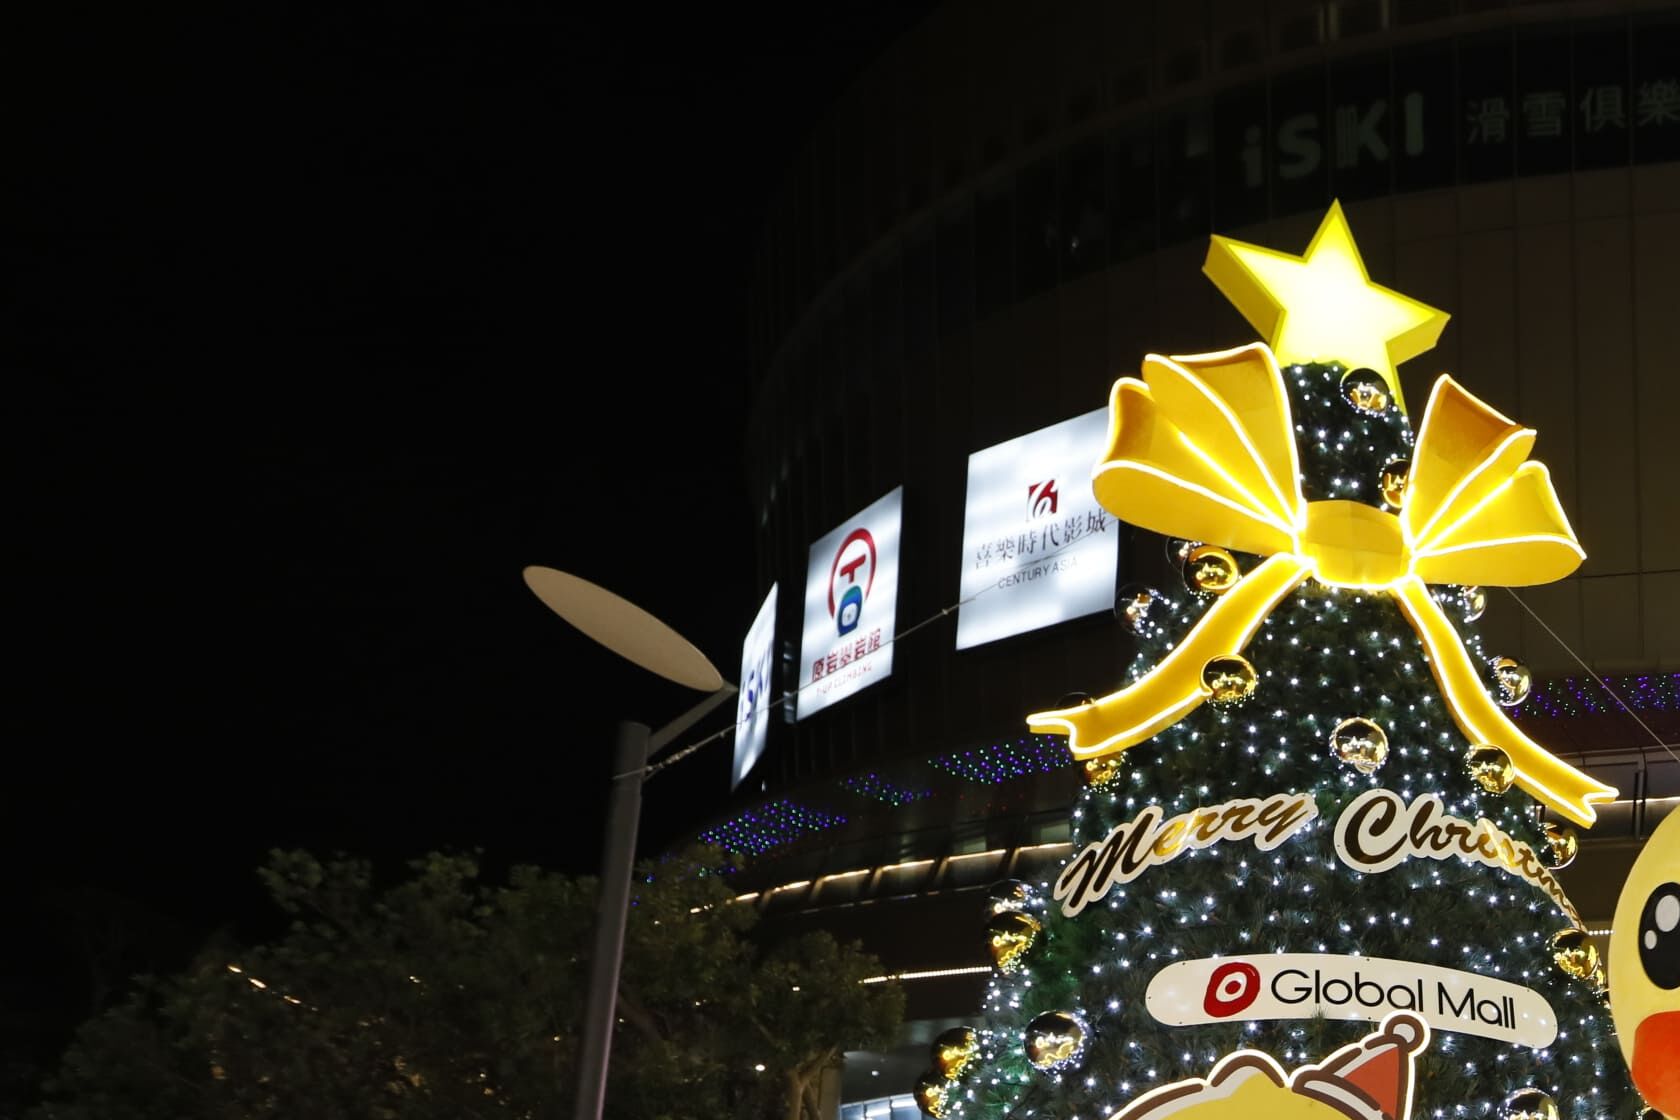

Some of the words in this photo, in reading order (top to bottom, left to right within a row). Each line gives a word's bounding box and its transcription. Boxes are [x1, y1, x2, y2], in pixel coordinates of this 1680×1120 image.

[1240, 91, 1424, 189] iSKI
[997, 562, 1050, 590] CENTURY
[1060, 799, 1309, 909] Merry
[1344, 796, 1583, 931] Christm
[1271, 968, 1424, 1013] Global
[1437, 981, 1516, 1030] Mall
